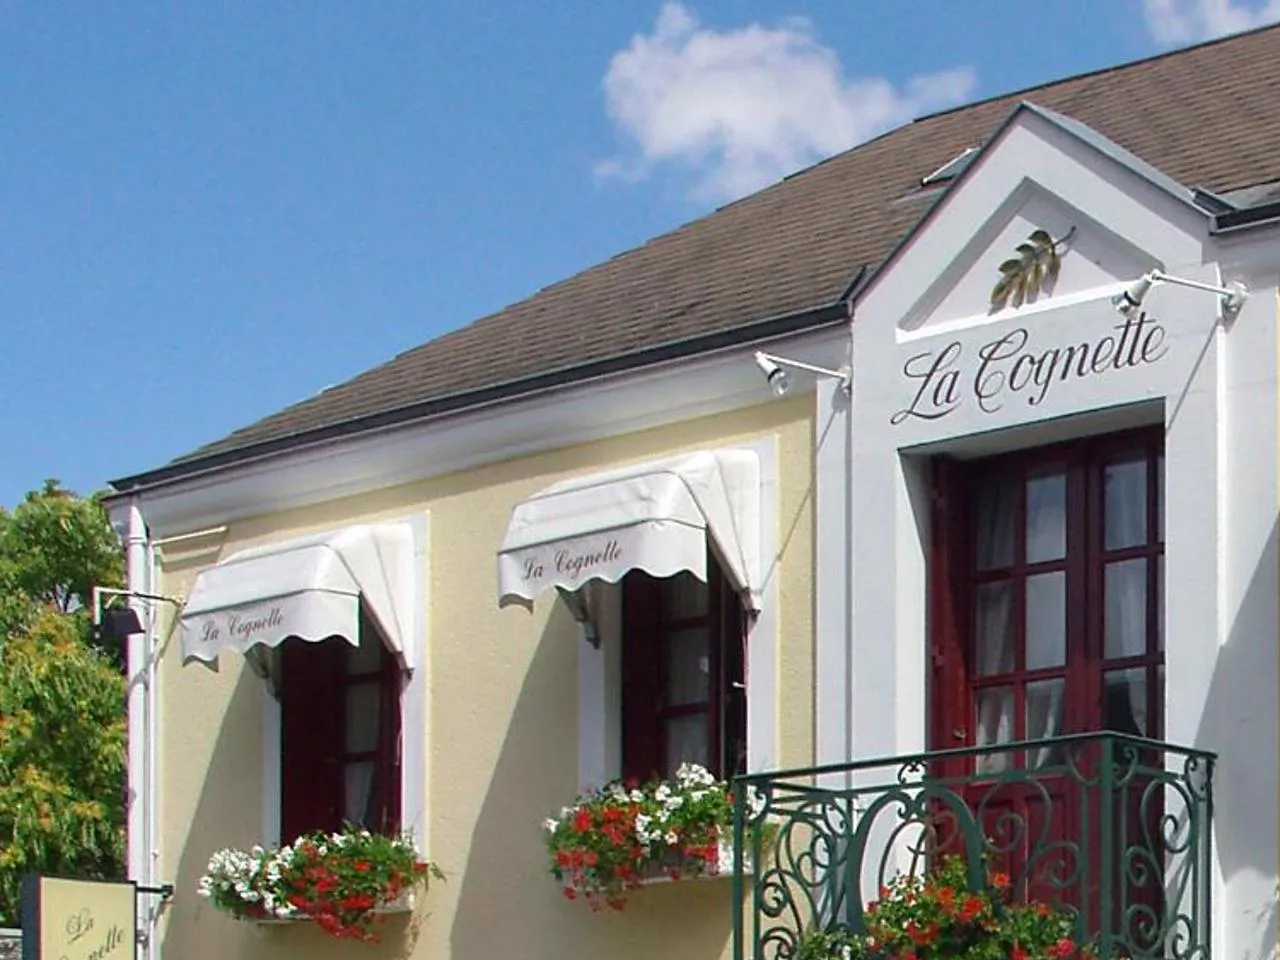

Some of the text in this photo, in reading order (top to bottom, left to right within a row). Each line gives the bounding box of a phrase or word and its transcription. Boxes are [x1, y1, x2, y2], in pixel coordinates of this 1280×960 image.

[891, 312, 1169, 425] La Cognette
[522, 539, 622, 581] La Cognette
[202, 607, 285, 643] La Cognette
[66, 907, 94, 944] La
